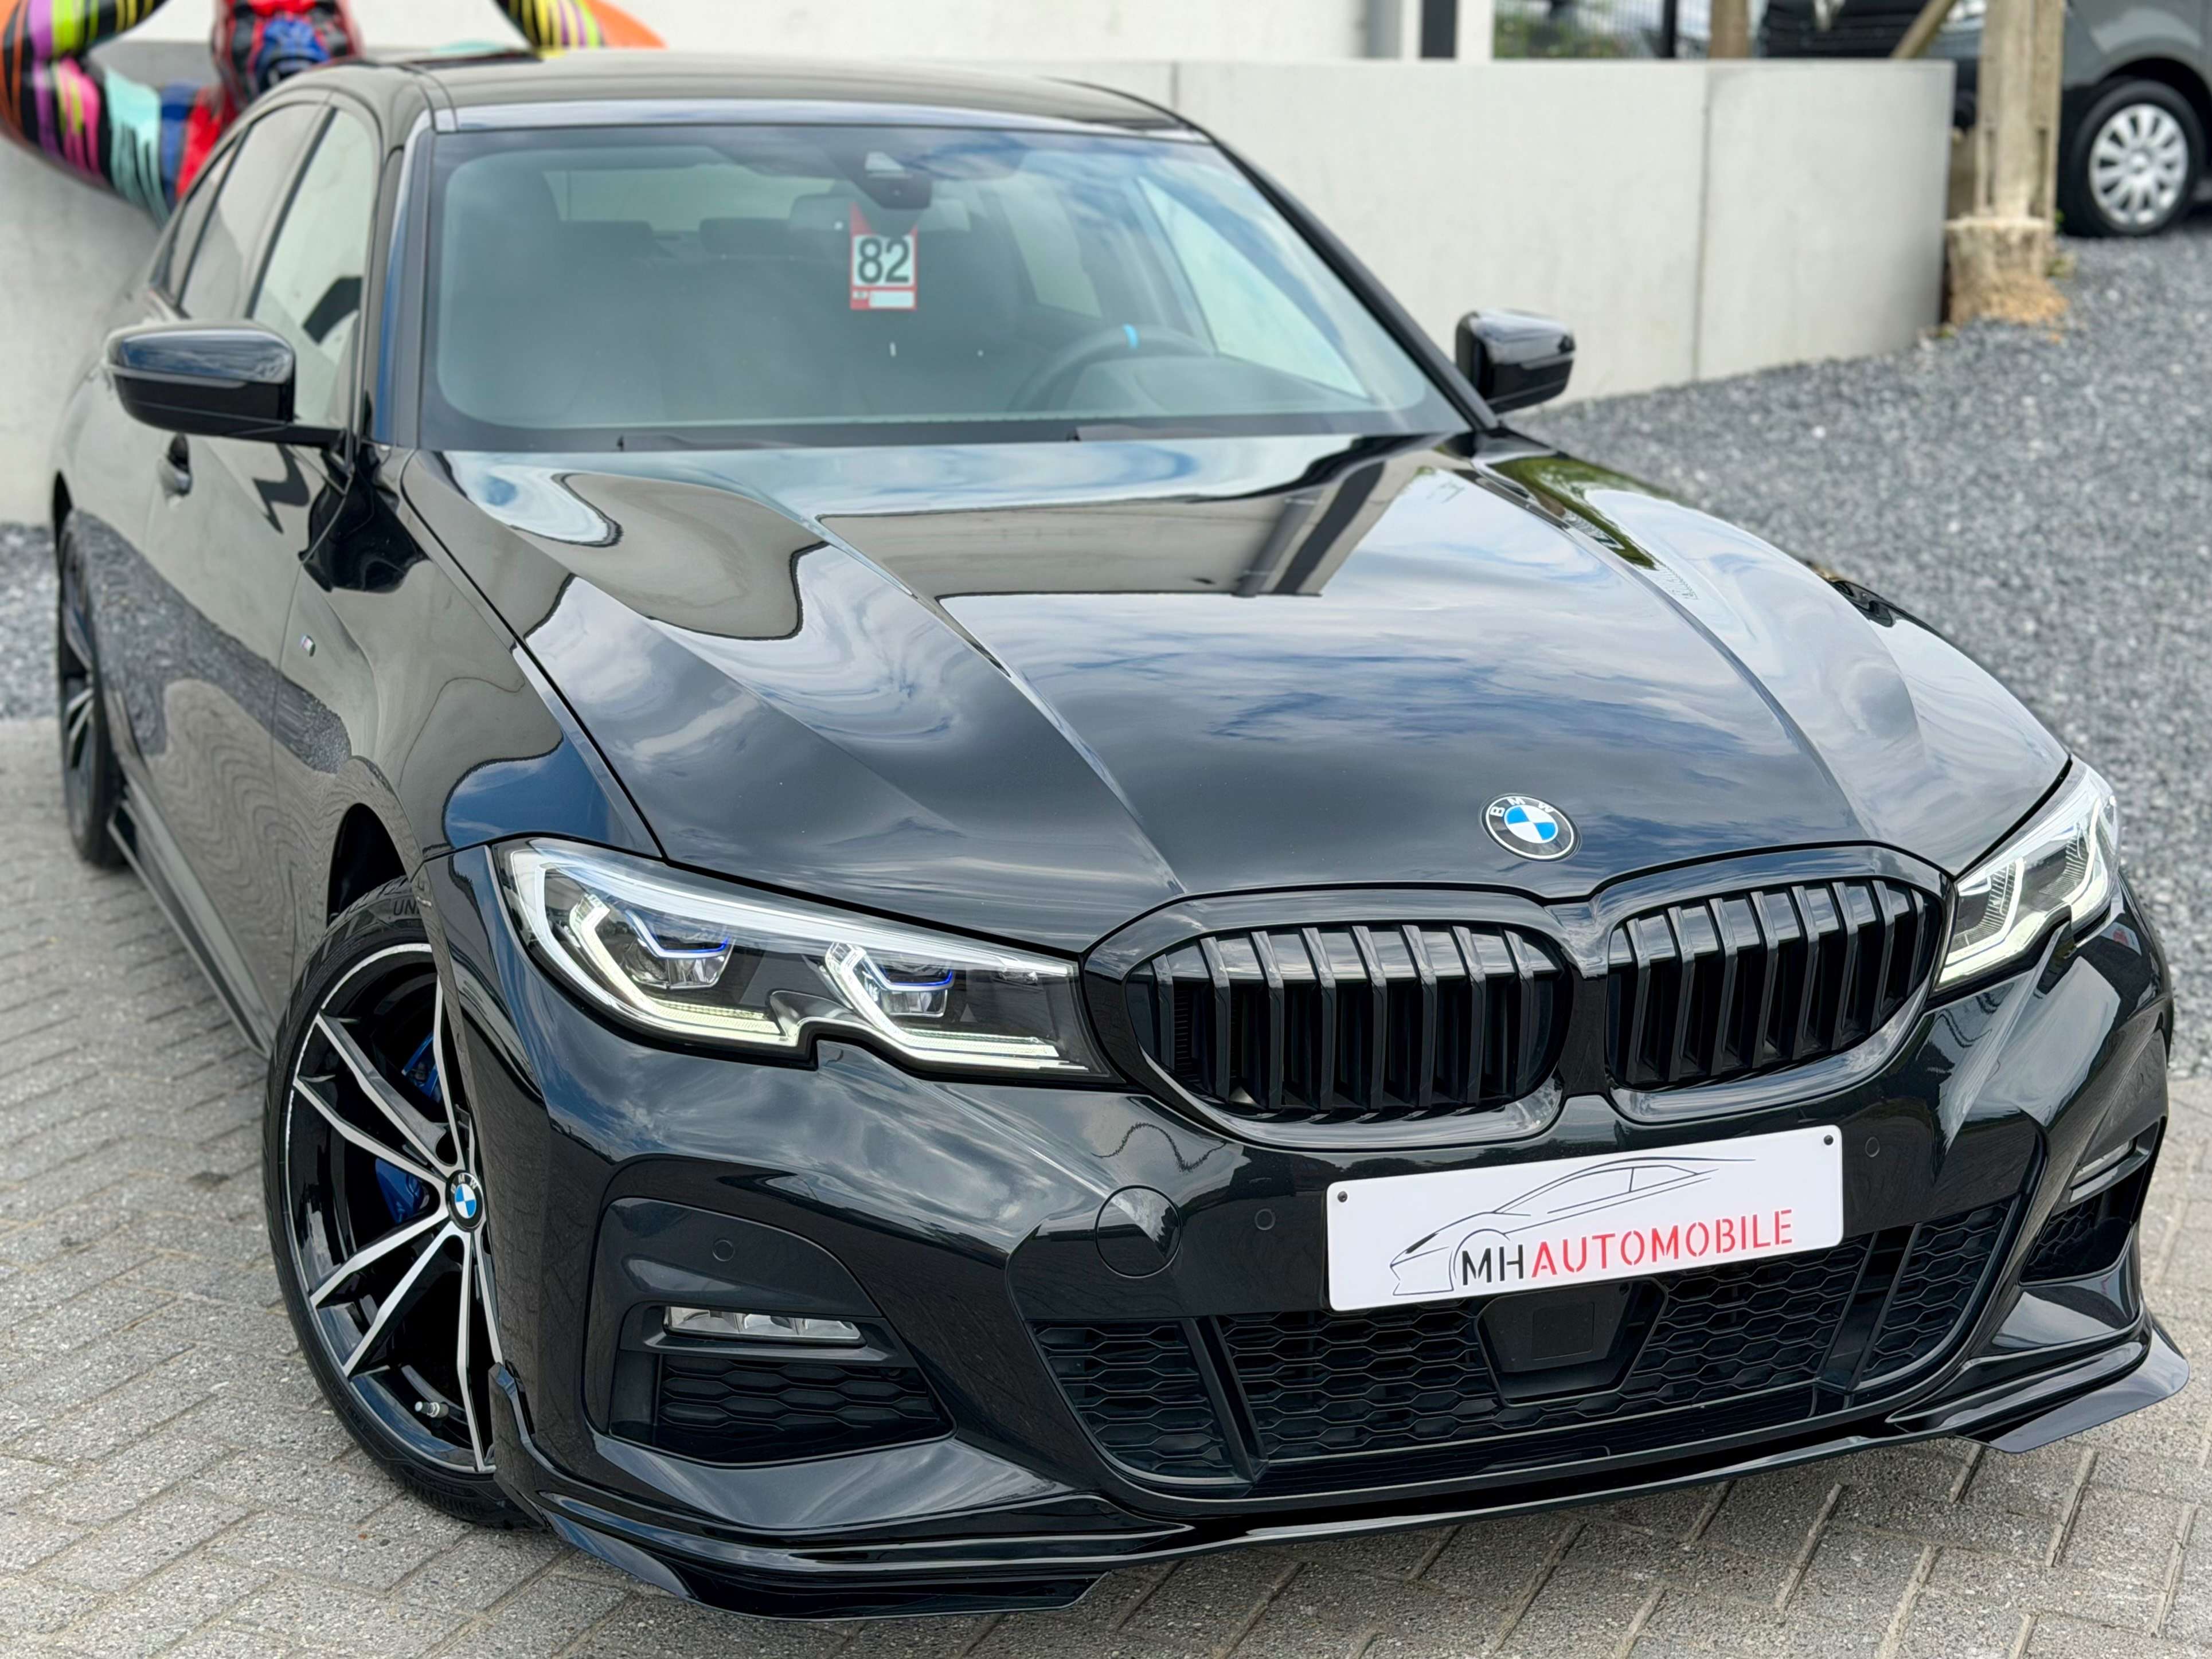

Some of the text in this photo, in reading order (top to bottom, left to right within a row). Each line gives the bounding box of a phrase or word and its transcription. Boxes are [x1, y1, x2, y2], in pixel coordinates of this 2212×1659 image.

[857, 237, 910, 284] 82
[1490, 797, 1556, 817] BMW
[450, 1173, 478, 1194] BMW
